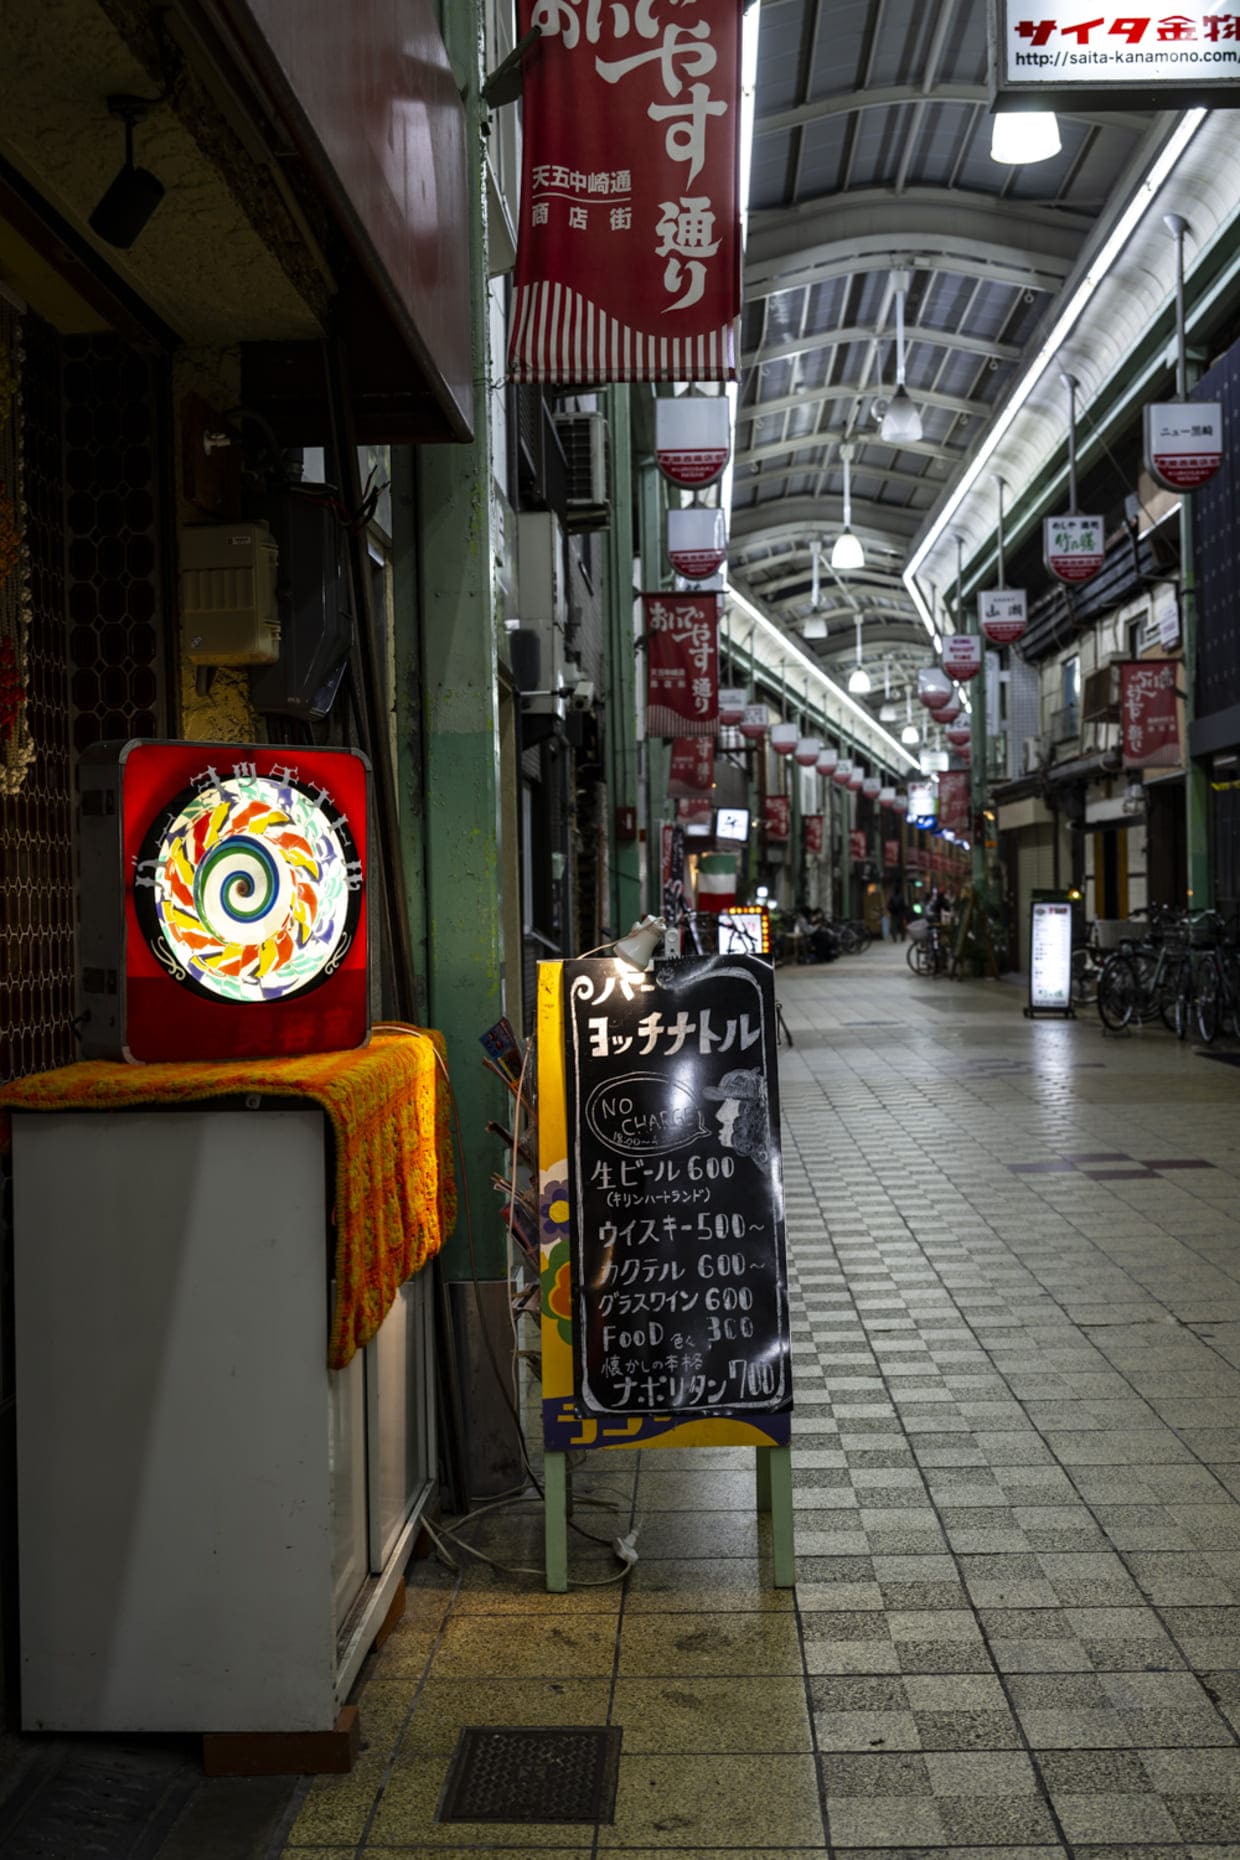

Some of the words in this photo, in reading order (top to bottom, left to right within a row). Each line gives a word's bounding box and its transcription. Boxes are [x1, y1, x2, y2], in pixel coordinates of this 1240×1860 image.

[531, 164, 632, 195] 天五中崎通
[649, 601, 715, 714] おいでやす通り
[588, 1008, 760, 1058] ヨッチナトル
[601, 1097, 634, 1120] NO
[590, 1159, 680, 1190] 生ビール
[687, 1155, 735, 1181] 600
[598, 1214, 692, 1248] ウイスキー
[596, 1257, 686, 1287] カクテル
[597, 1291, 699, 1317] グラスワイン
[705, 1287, 753, 1311] 600
[706, 1316, 754, 1343] 300
[612, 1374, 728, 1408] ナポリタン
[729, 1359, 775, 1400] 700
